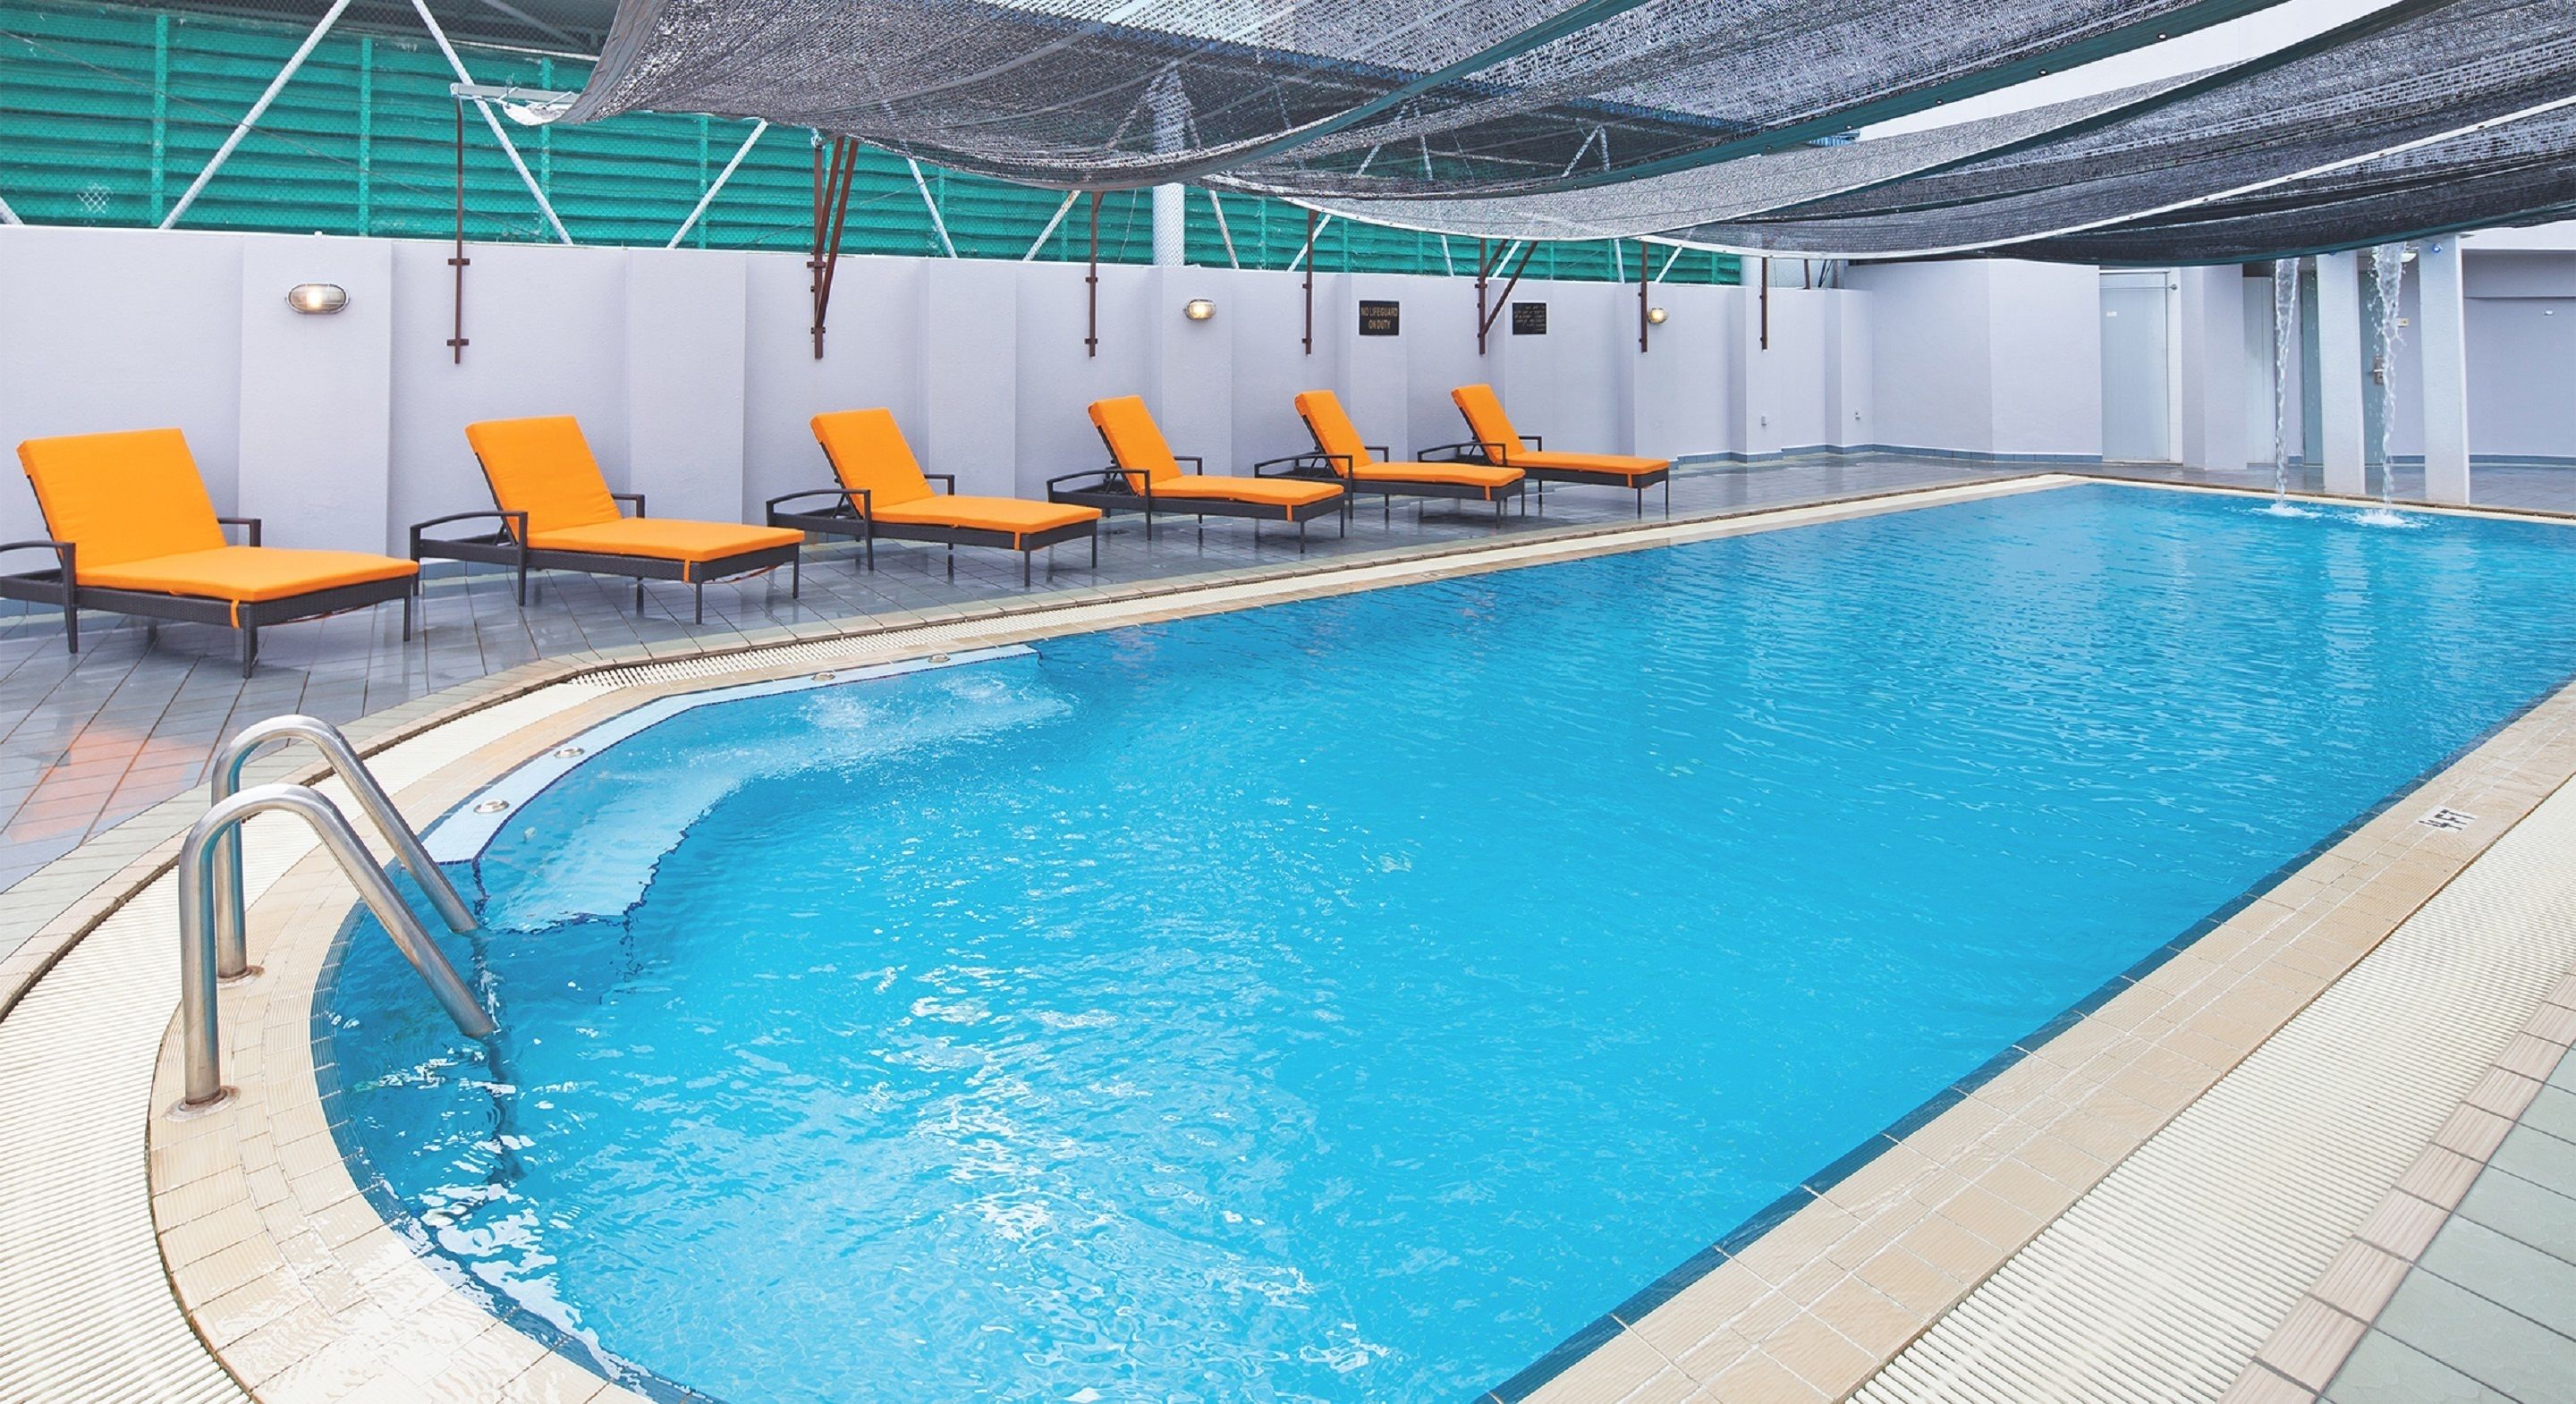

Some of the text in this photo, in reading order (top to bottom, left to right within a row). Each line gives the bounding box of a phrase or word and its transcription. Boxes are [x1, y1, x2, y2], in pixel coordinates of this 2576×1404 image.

[1360, 308, 1398, 317] NO LIFEGUARD
[1368, 319, 1391, 329] ON DUTY
